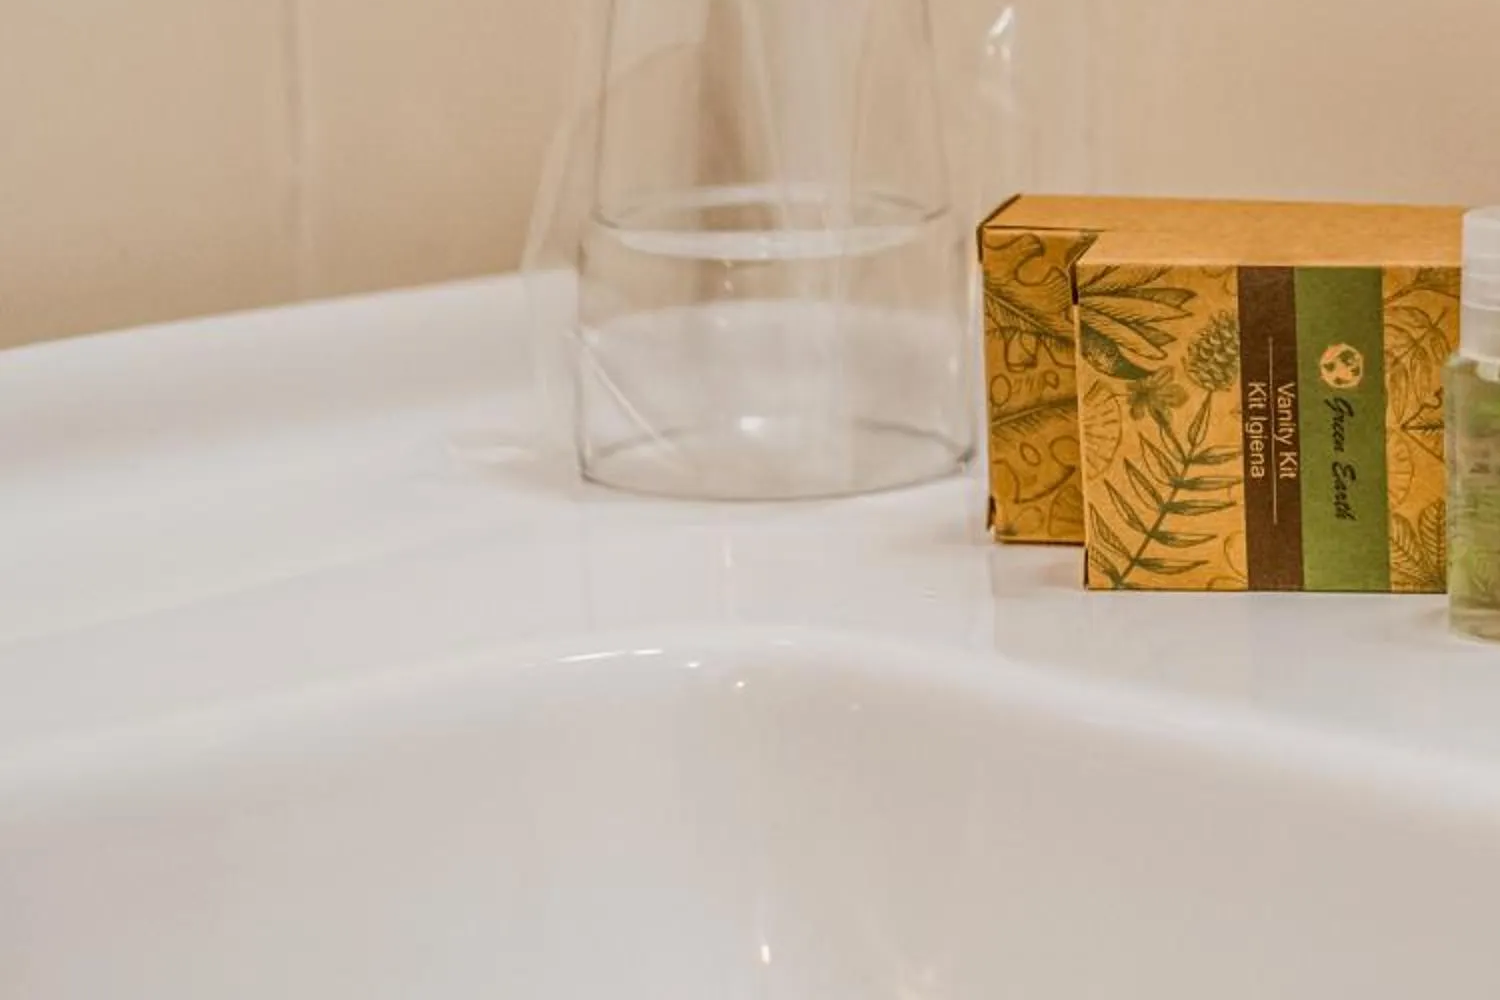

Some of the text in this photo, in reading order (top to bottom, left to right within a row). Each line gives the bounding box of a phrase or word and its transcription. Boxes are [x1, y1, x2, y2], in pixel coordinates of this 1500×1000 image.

[1245, 381, 1269, 479] Kit Igiena
[1273, 381, 1298, 479] Vanity Kit
[1323, 396, 1357, 521] Green Earth
